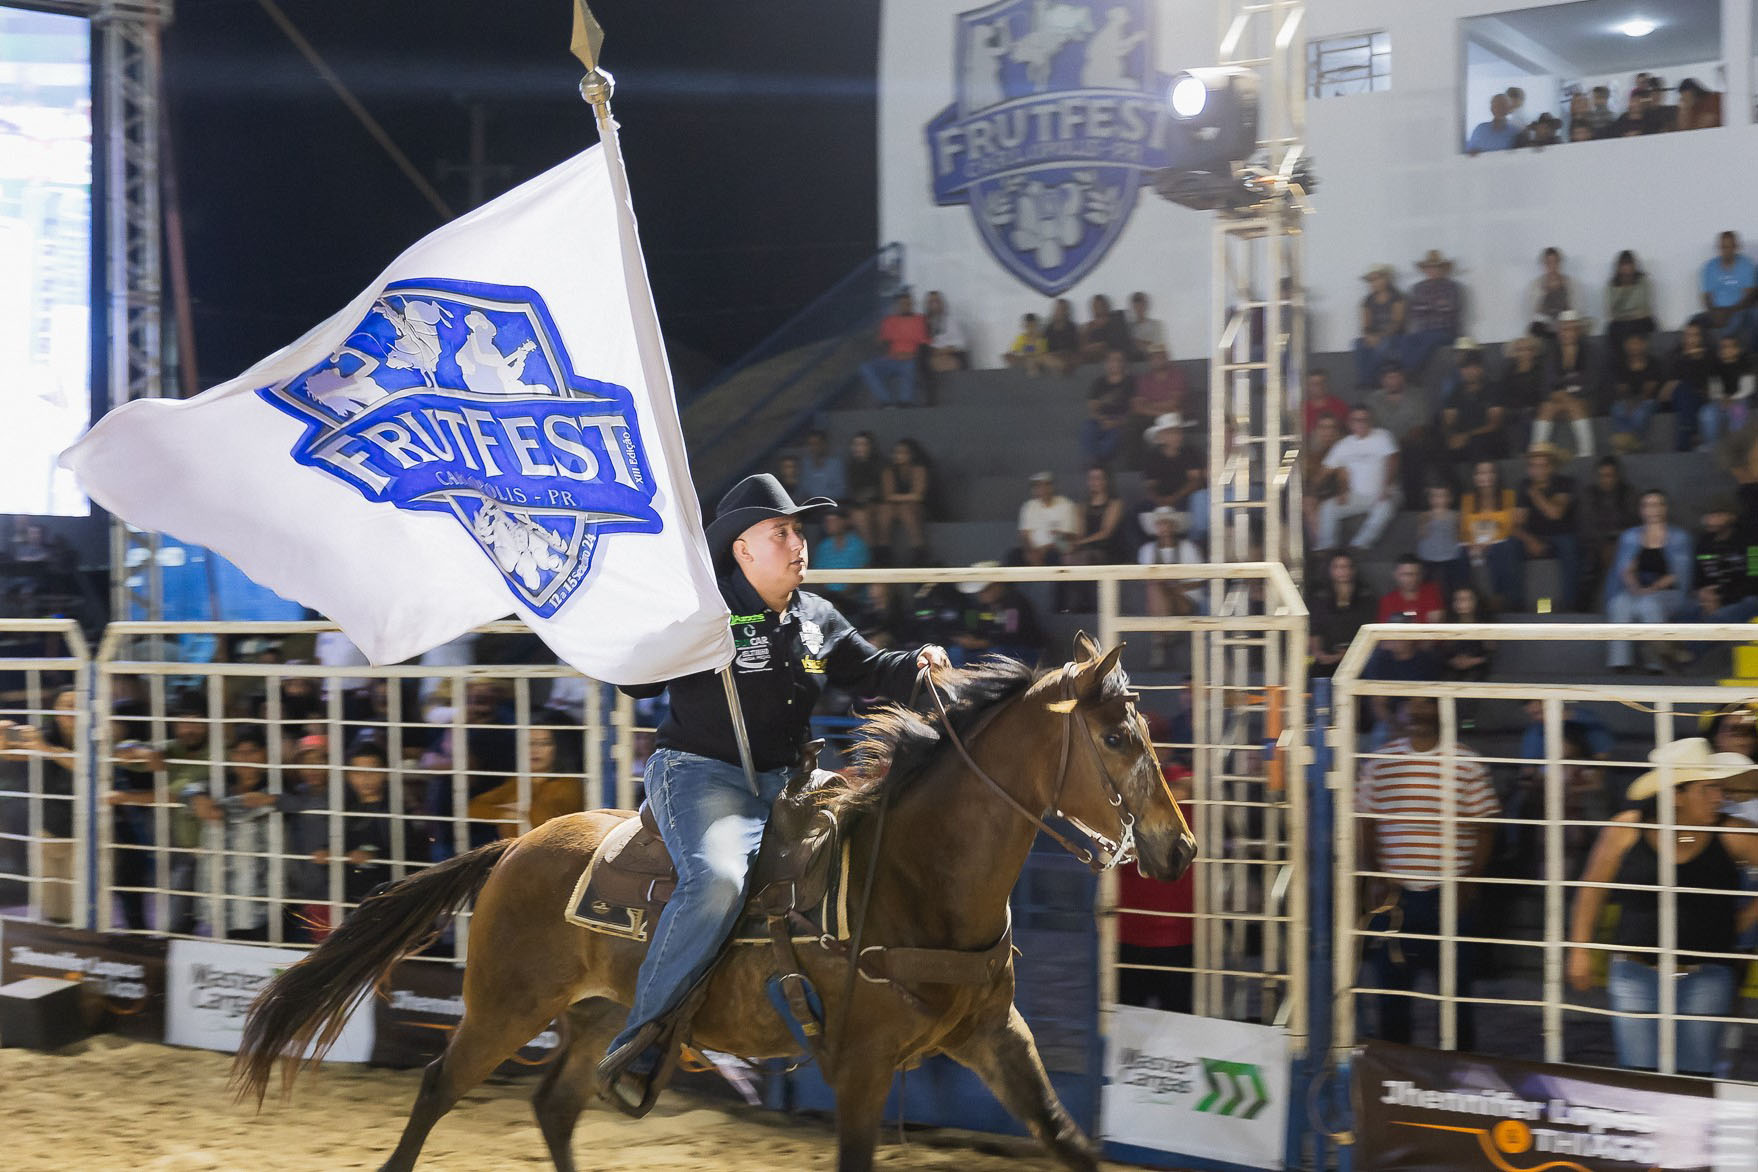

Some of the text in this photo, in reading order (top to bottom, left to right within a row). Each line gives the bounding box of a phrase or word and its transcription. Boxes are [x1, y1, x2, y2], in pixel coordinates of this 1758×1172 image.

[937, 97, 1170, 176] FRUTFEST
[312, 406, 640, 496] FRUTFEST
[622, 431, 639, 465] Edição
[547, 489, 577, 507] PR
[581, 533, 597, 551] 24
